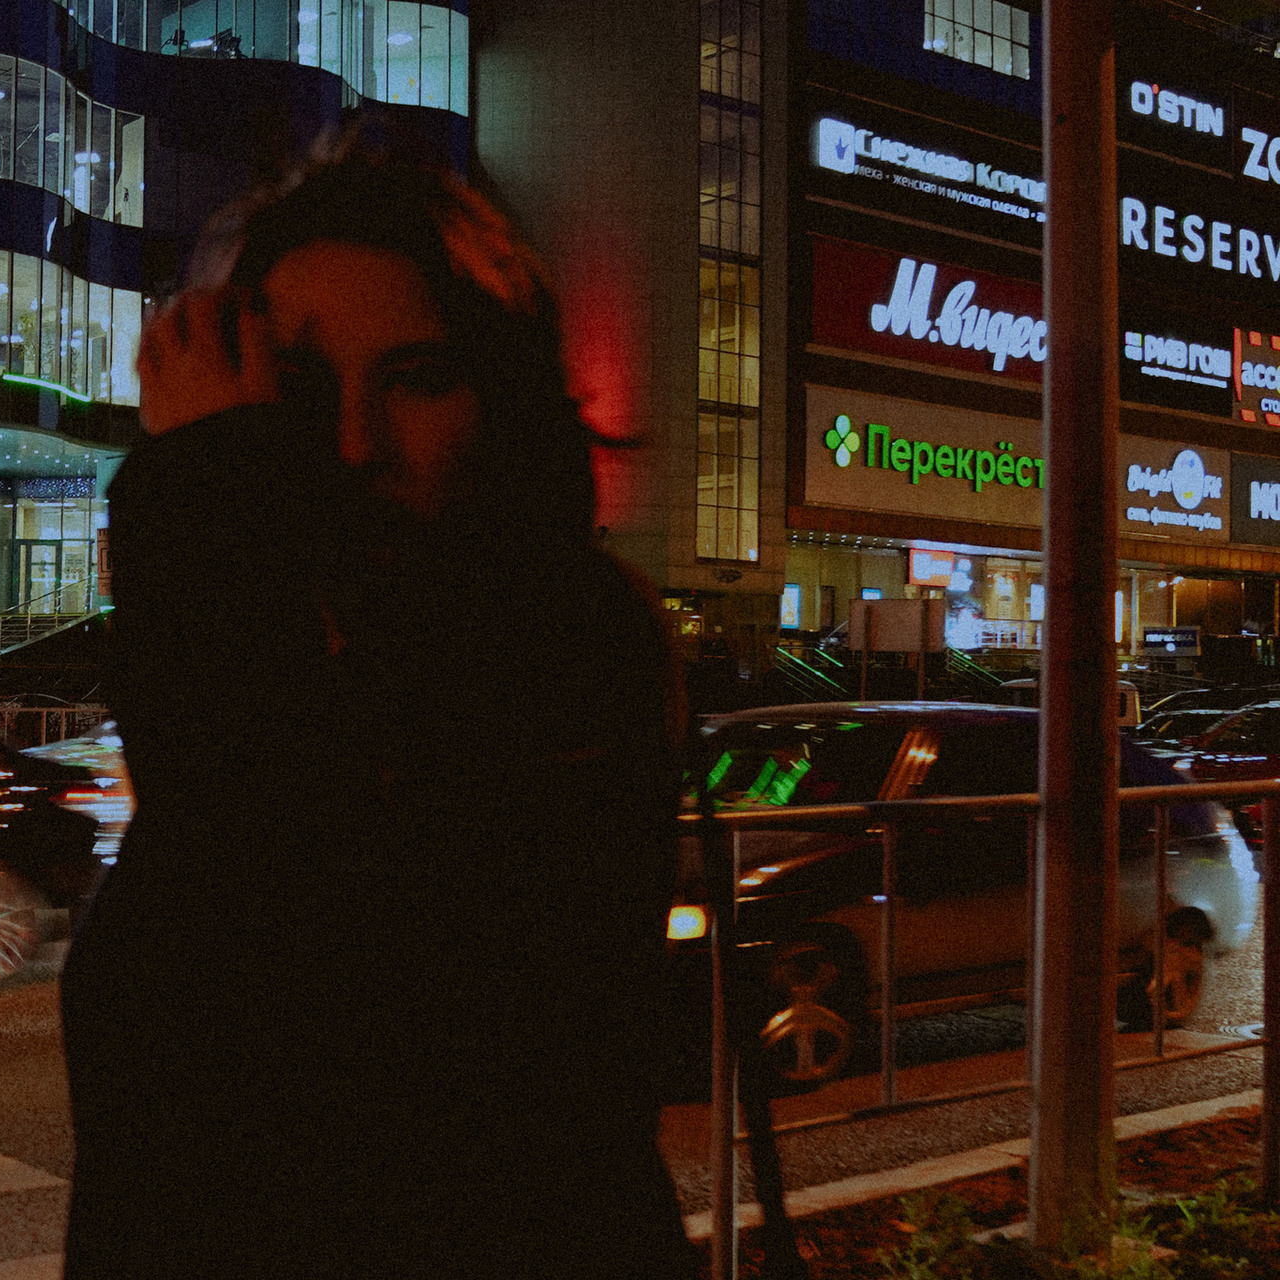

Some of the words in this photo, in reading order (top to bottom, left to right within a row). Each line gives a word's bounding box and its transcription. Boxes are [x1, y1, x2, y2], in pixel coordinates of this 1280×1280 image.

[1131, 81, 1224, 137] O'STIN
[854, 165, 883, 180] меха
[893, 174, 937, 194] женская
[937, 185, 946, 197] и
[946, 188, 991, 209] мужская
[991, 200, 1030, 219] одежда
